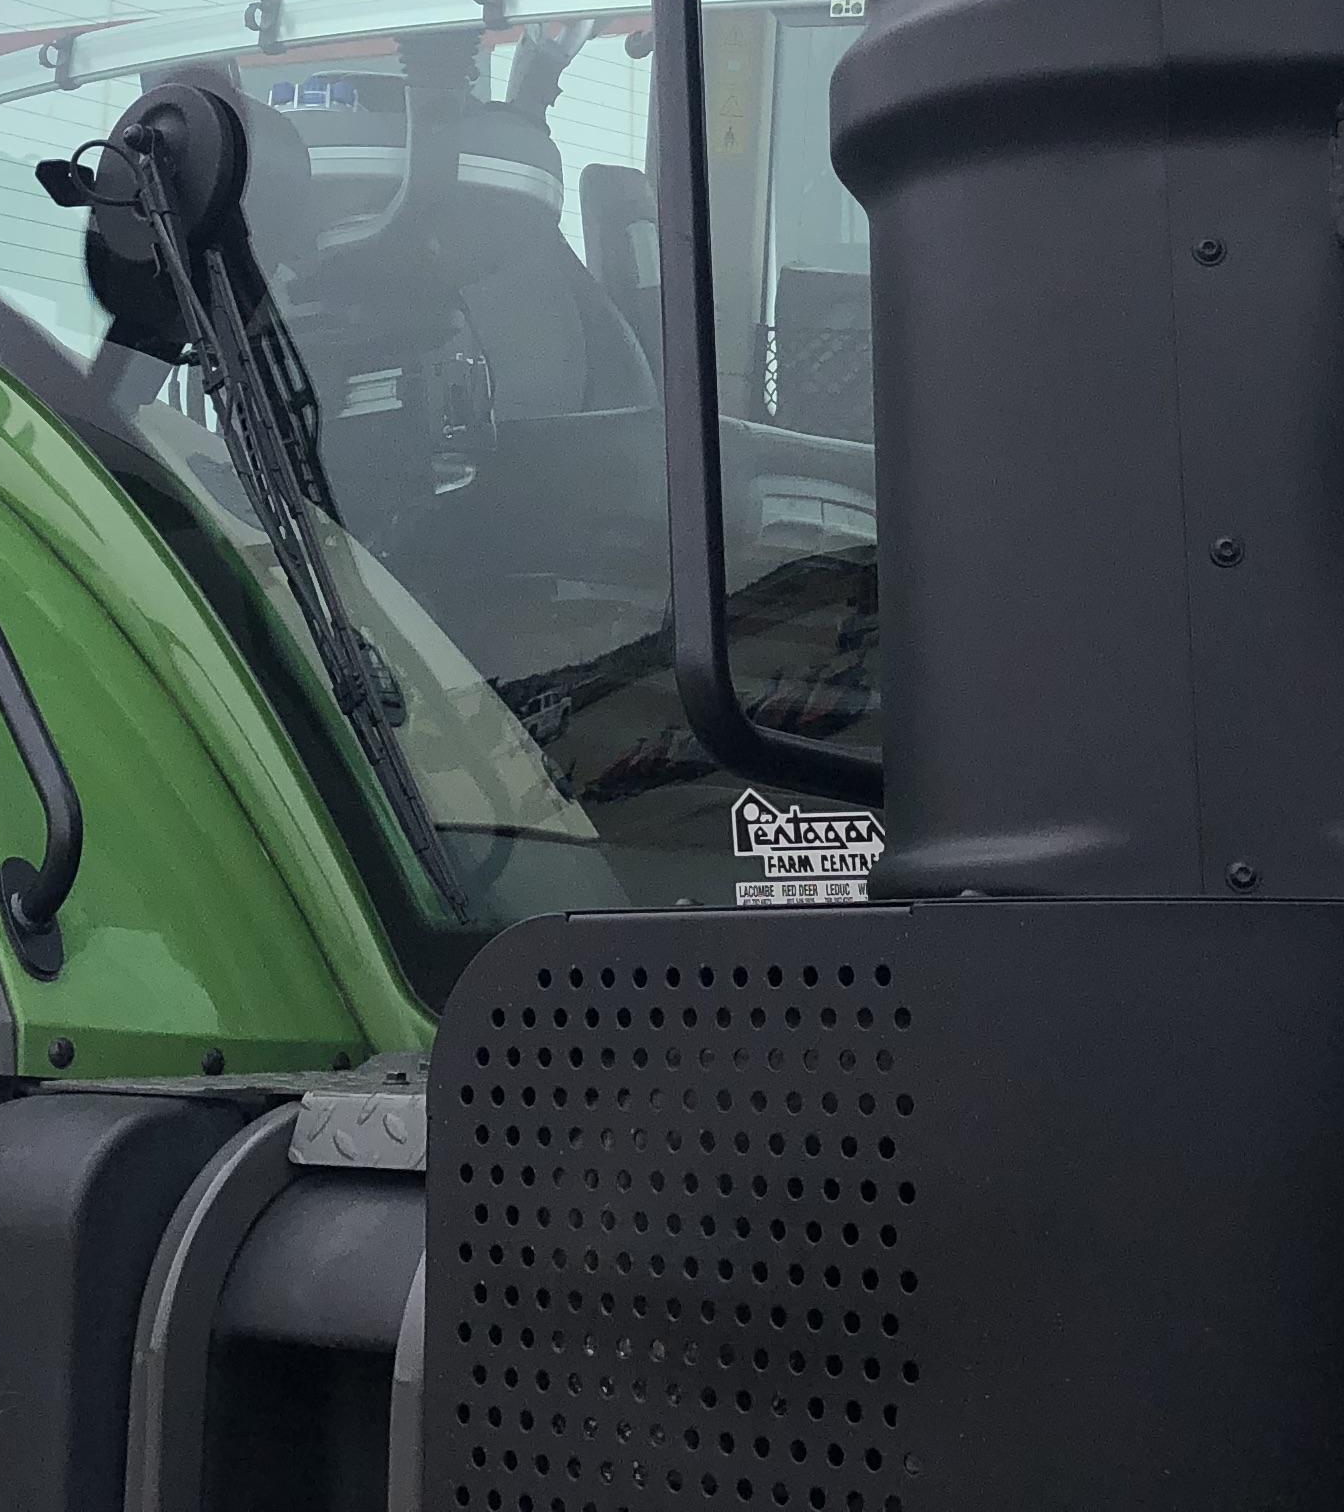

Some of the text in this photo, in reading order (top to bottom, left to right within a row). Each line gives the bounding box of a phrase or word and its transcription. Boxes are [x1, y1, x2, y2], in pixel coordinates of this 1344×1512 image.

[768, 855, 815, 874] FARM
[739, 885, 775, 898] LACOMBE
[782, 885, 797, 897] RED
[798, 884, 819, 896] DEER
[825, 883, 851, 896] LEDUC
